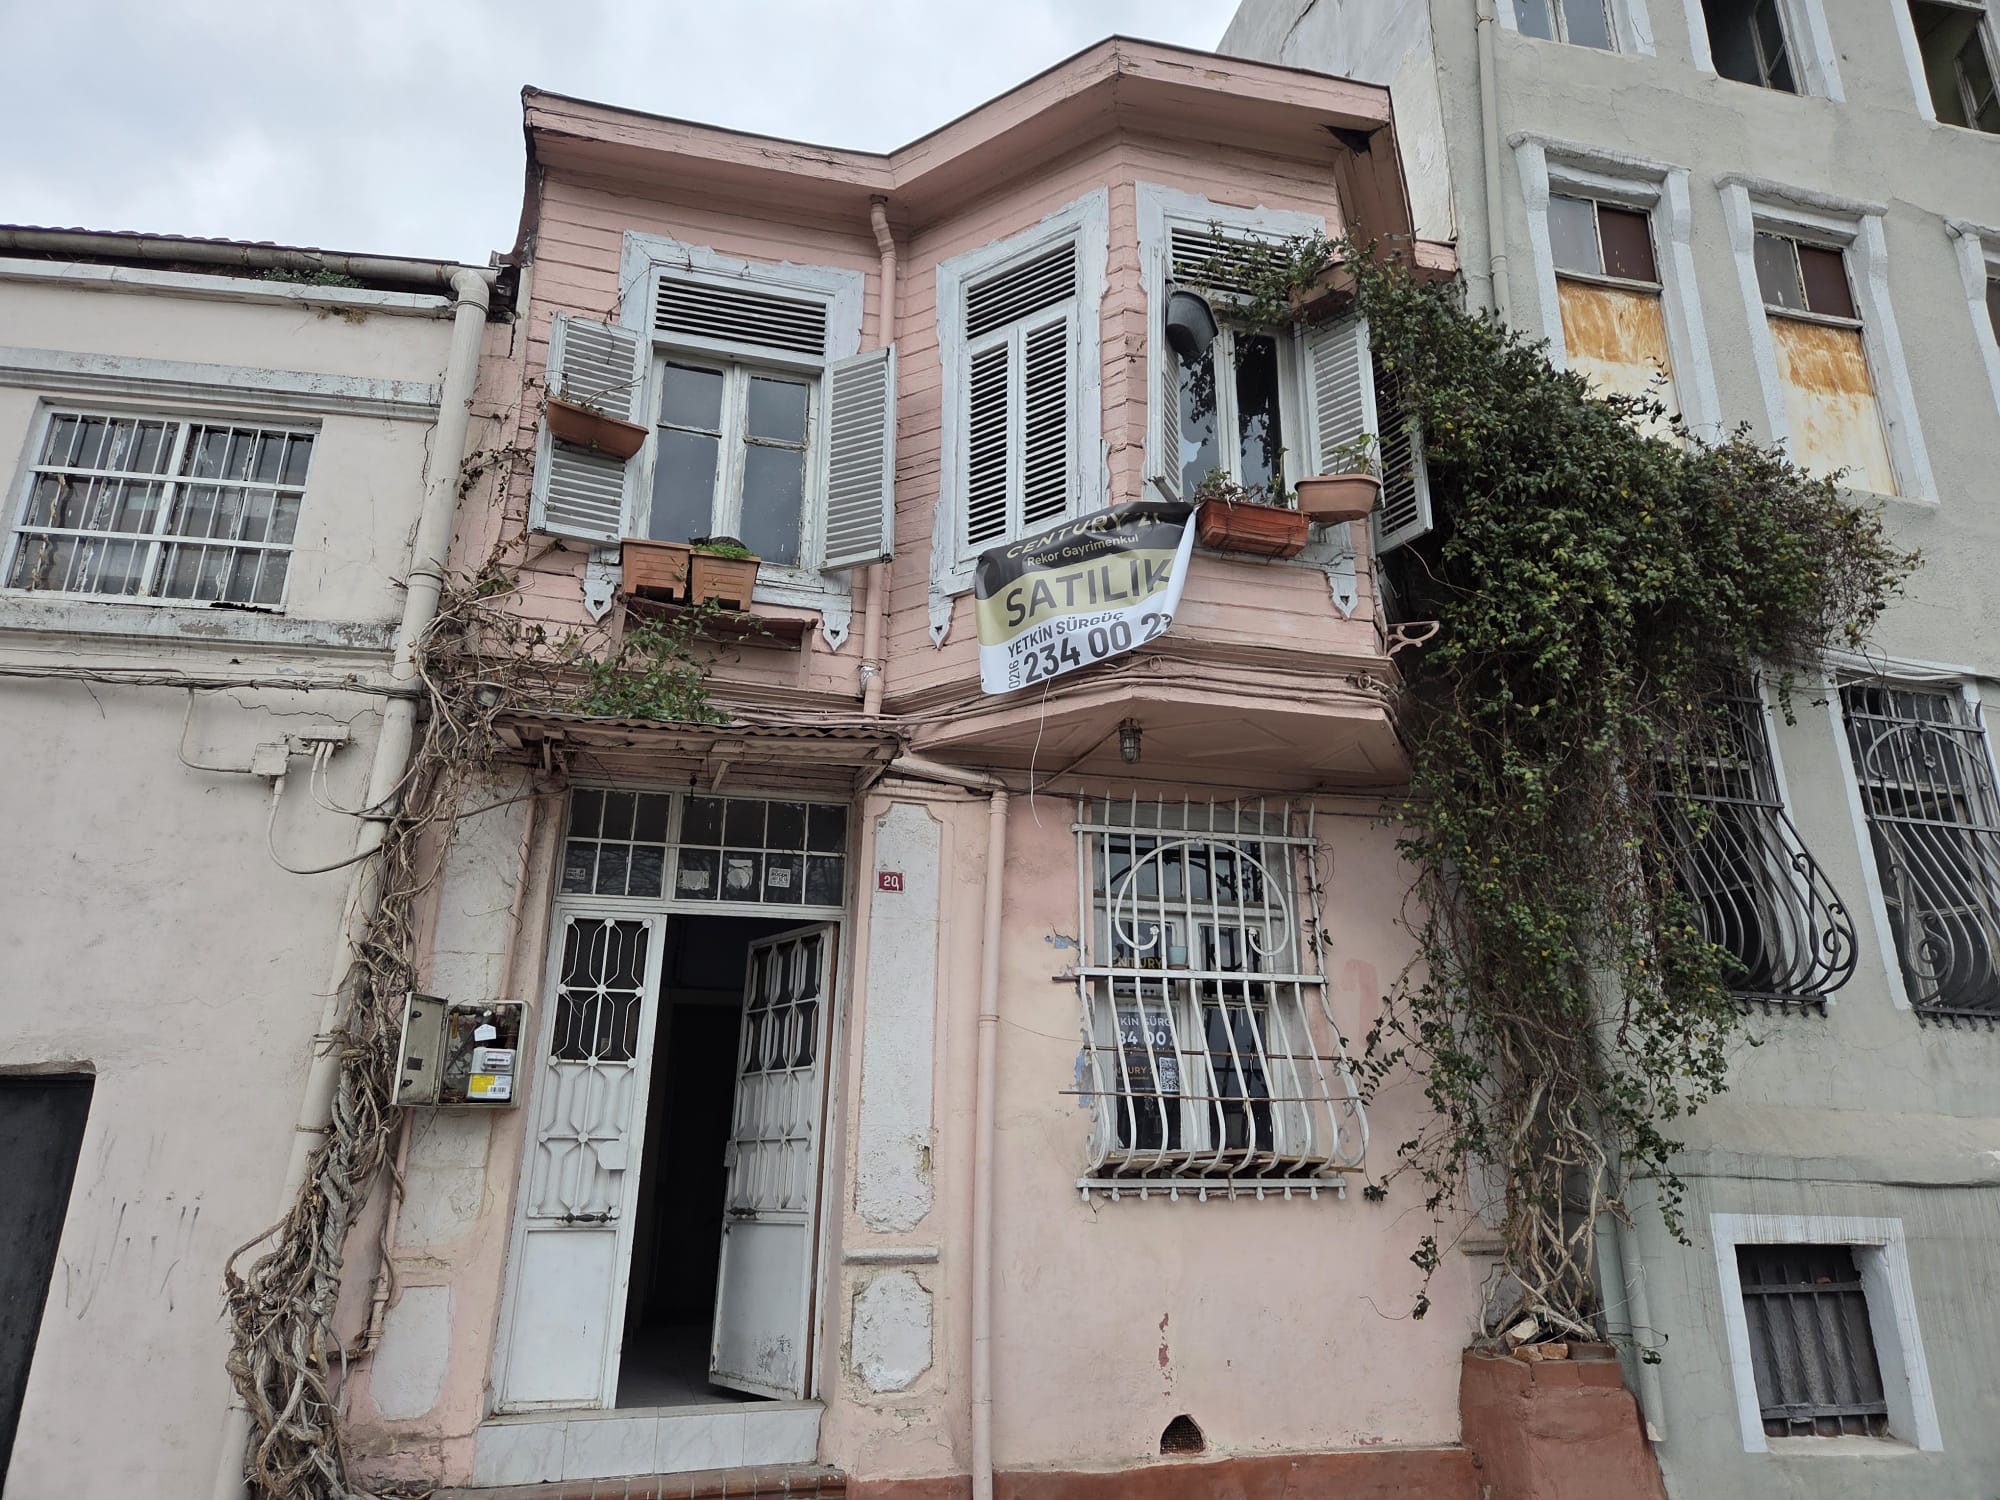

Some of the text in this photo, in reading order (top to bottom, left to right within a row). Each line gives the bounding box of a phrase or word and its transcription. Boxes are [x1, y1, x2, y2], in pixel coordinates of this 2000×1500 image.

[1006, 512, 1129, 559] CENTURY
[1027, 534, 1139, 567] Rekor Gayrimenkul
[1006, 558, 1171, 627] SATILIK
[1008, 612, 1124, 658] YETKİN SÜRGÜÇ
[1008, 659, 1021, 689] 0216
[1023, 637, 1080, 683] 234
[1087, 621, 1132, 658] 00
[883, 875, 899, 887] 20
